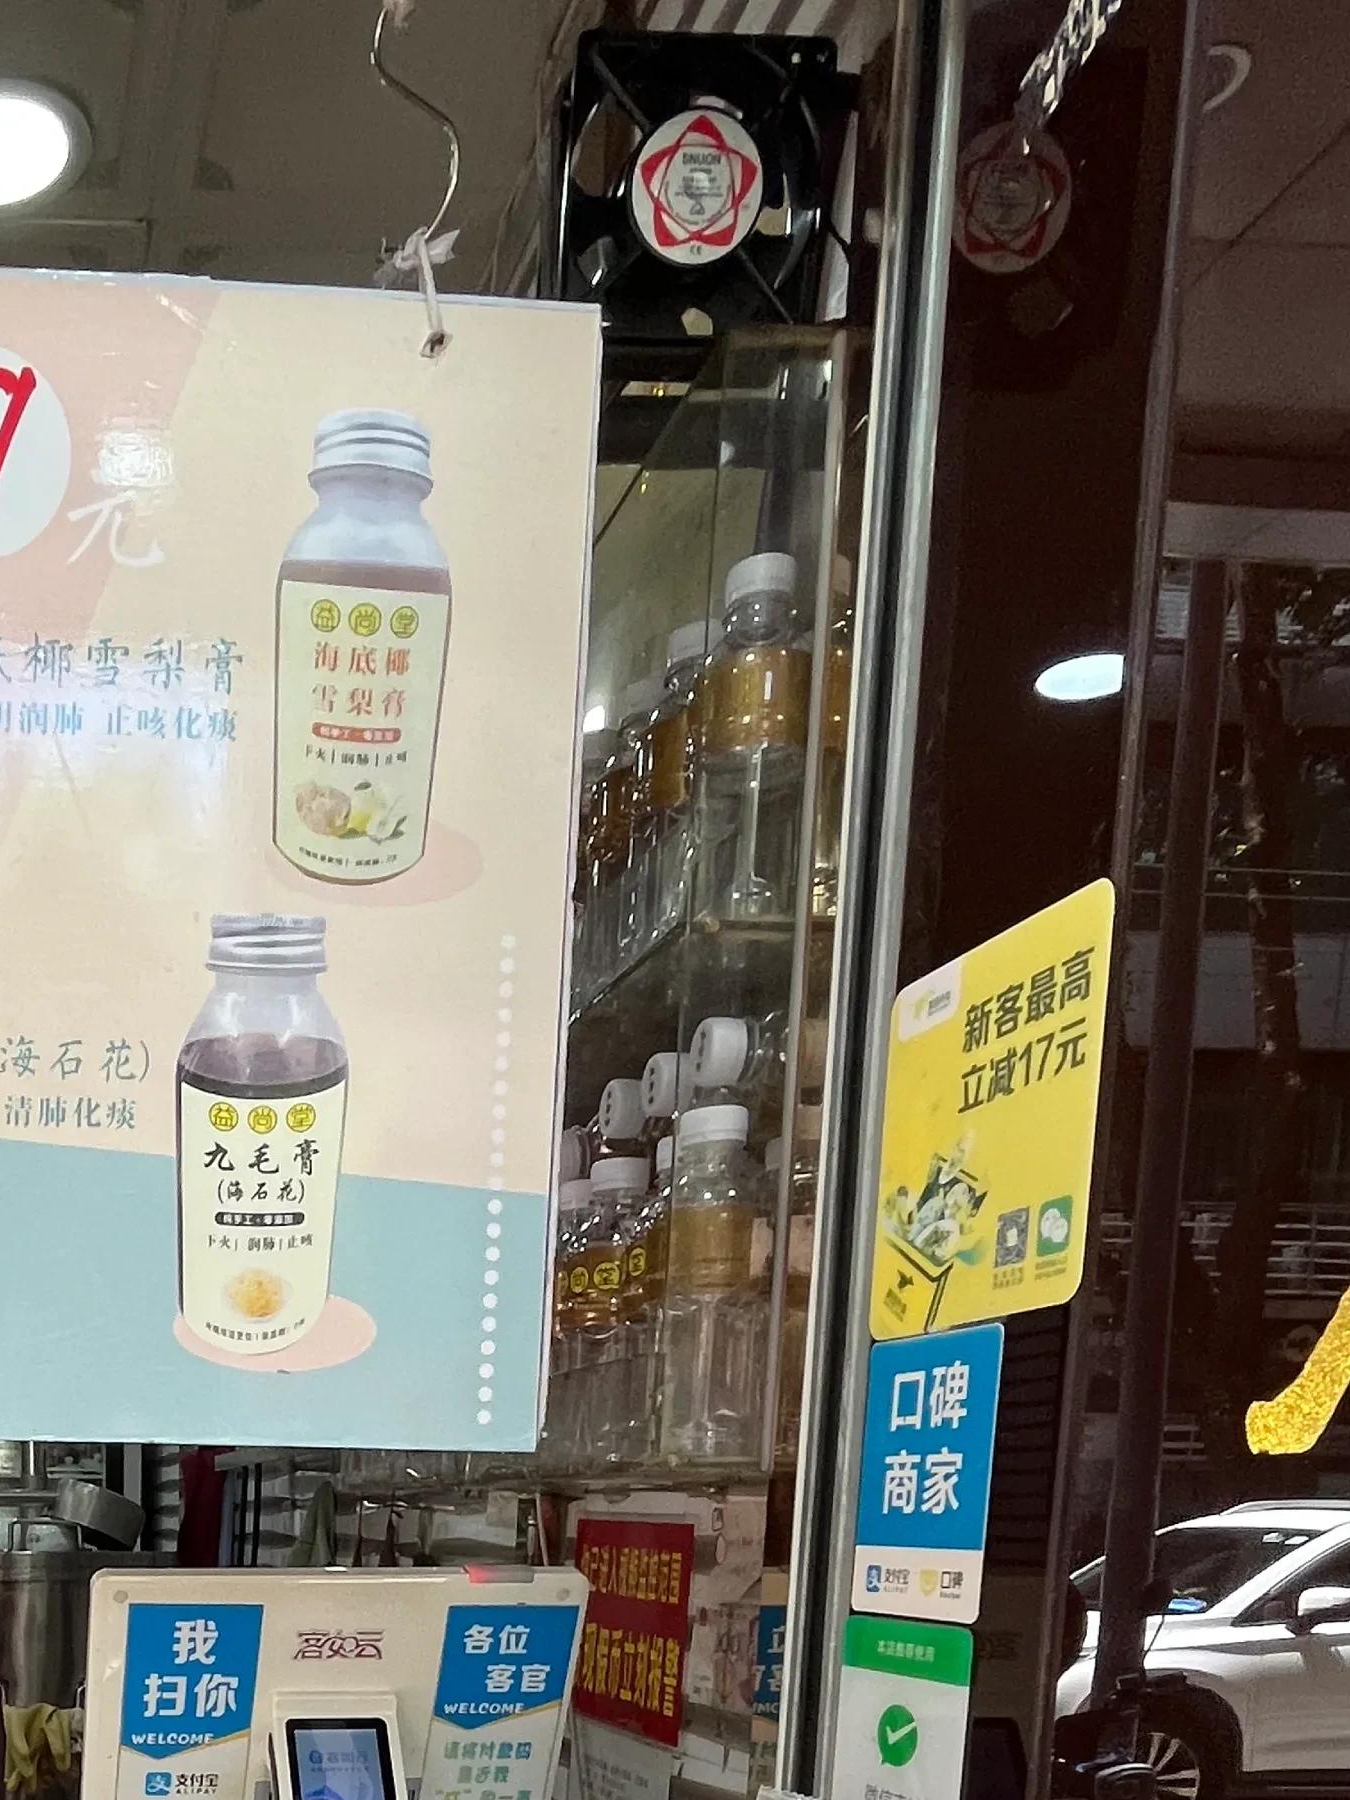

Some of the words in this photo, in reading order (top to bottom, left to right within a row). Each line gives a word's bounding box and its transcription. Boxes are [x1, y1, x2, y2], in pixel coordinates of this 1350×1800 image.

[67, 489, 164, 566] 元
[313, 641, 411, 675] 海底椰
[311, 683, 406, 718] 雪梨膏
[106, 704, 237, 742] 止咳化痰
[962, 946, 1096, 1053] 新客最高
[958, 1017, 1088, 1114] 立减17元
[4, 1095, 137, 1132] 清肺化痰
[204, 1139, 320, 1176] 九毛膏
[217, 1178, 306, 1204] (海石花)
[890, 1360, 971, 1432] 口碑
[882, 1446, 964, 1515] 商家
[172, 1619, 219, 1665] 我
[463, 1624, 531, 1655] 各位
[485, 1664, 551, 1693] 客官
[577, 1622, 681, 1717] 现假币立刻报警
[143, 1673, 239, 1718] 扫你
[443, 1702, 526, 1715] WELCOME
[131, 1732, 214, 1746] WELCOME
[175, 1773, 219, 1788] 支付宝
